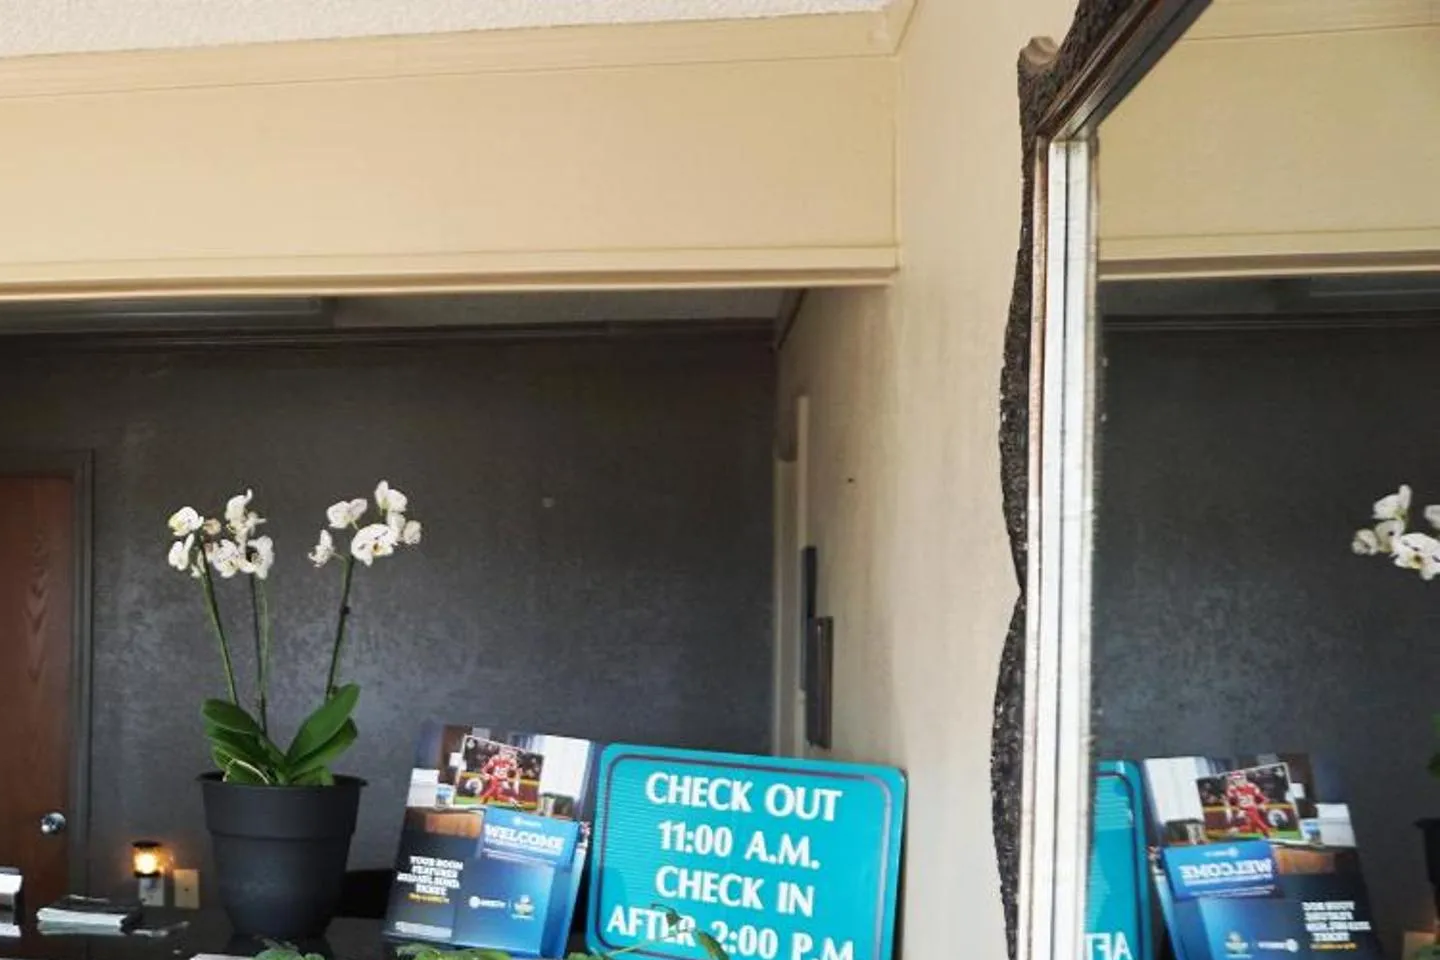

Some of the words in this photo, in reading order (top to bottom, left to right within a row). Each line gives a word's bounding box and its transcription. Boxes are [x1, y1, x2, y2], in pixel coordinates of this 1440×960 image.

[645, 772, 753, 813] CHECK
[764, 783, 843, 822] OUT
[484, 824, 565, 849] WELCOME
[657, 820, 733, 858] 11:00
[744, 830, 821, 870] A.M.
[655, 866, 765, 910] CHECK
[776, 881, 815, 918] IN
[710, 920, 779, 960] 2:00
